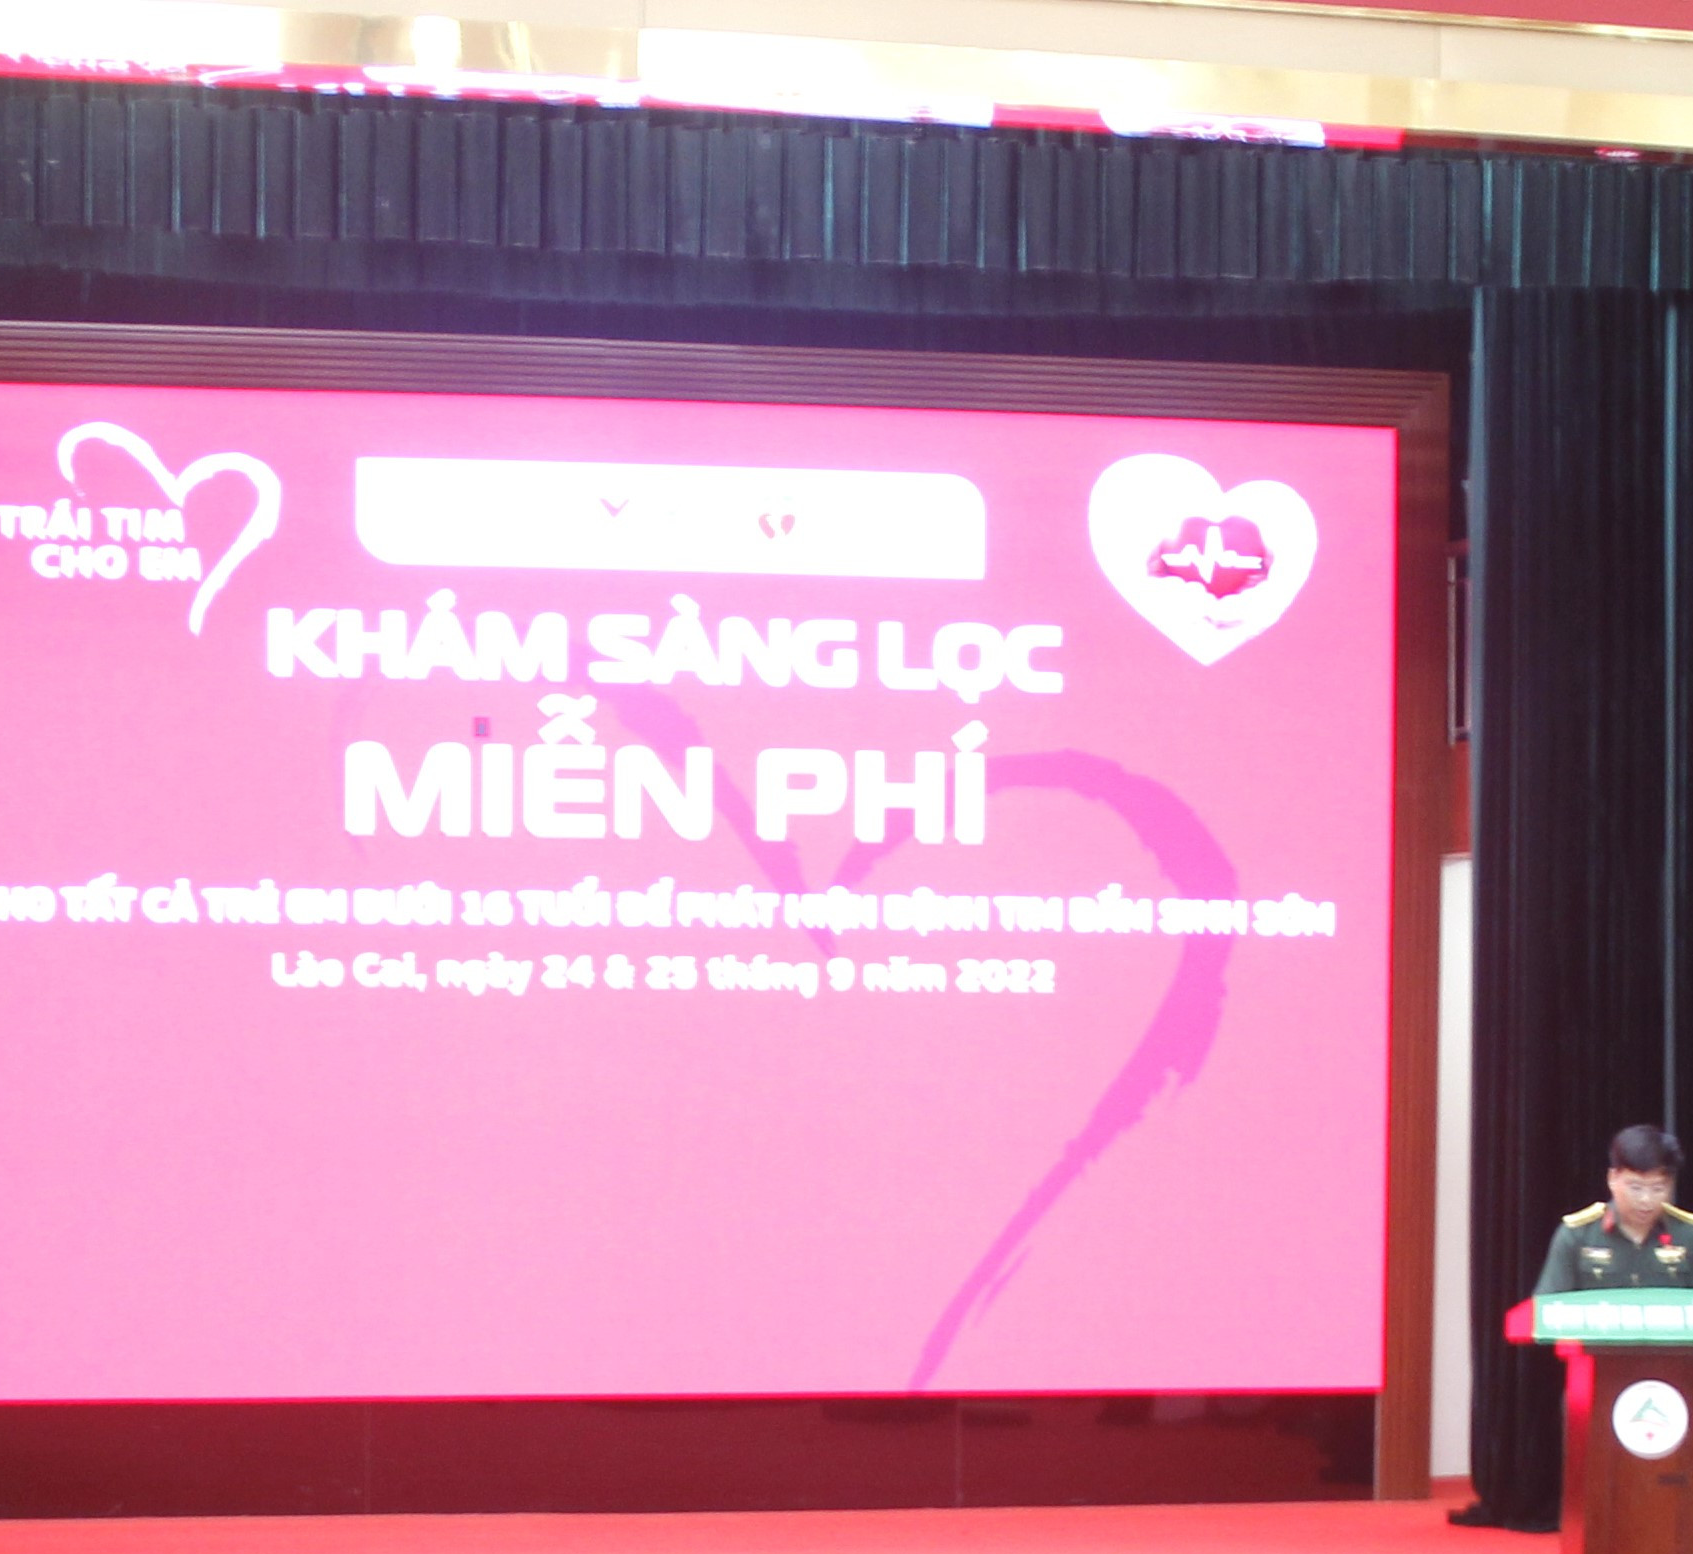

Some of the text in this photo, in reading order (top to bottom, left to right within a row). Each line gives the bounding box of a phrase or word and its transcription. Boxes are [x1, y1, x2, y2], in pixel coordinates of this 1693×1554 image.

[102, 507, 185, 543] TIM
[32, 545, 202, 581] CHO EM
[268, 590, 1064, 705] KHÁM SÀNG LỌC
[346, 695, 989, 845] MIỄN PHÍ
[273, 952, 1056, 999] Lào Cai, ngày 24 & 25 tháng 9 năm 2022
